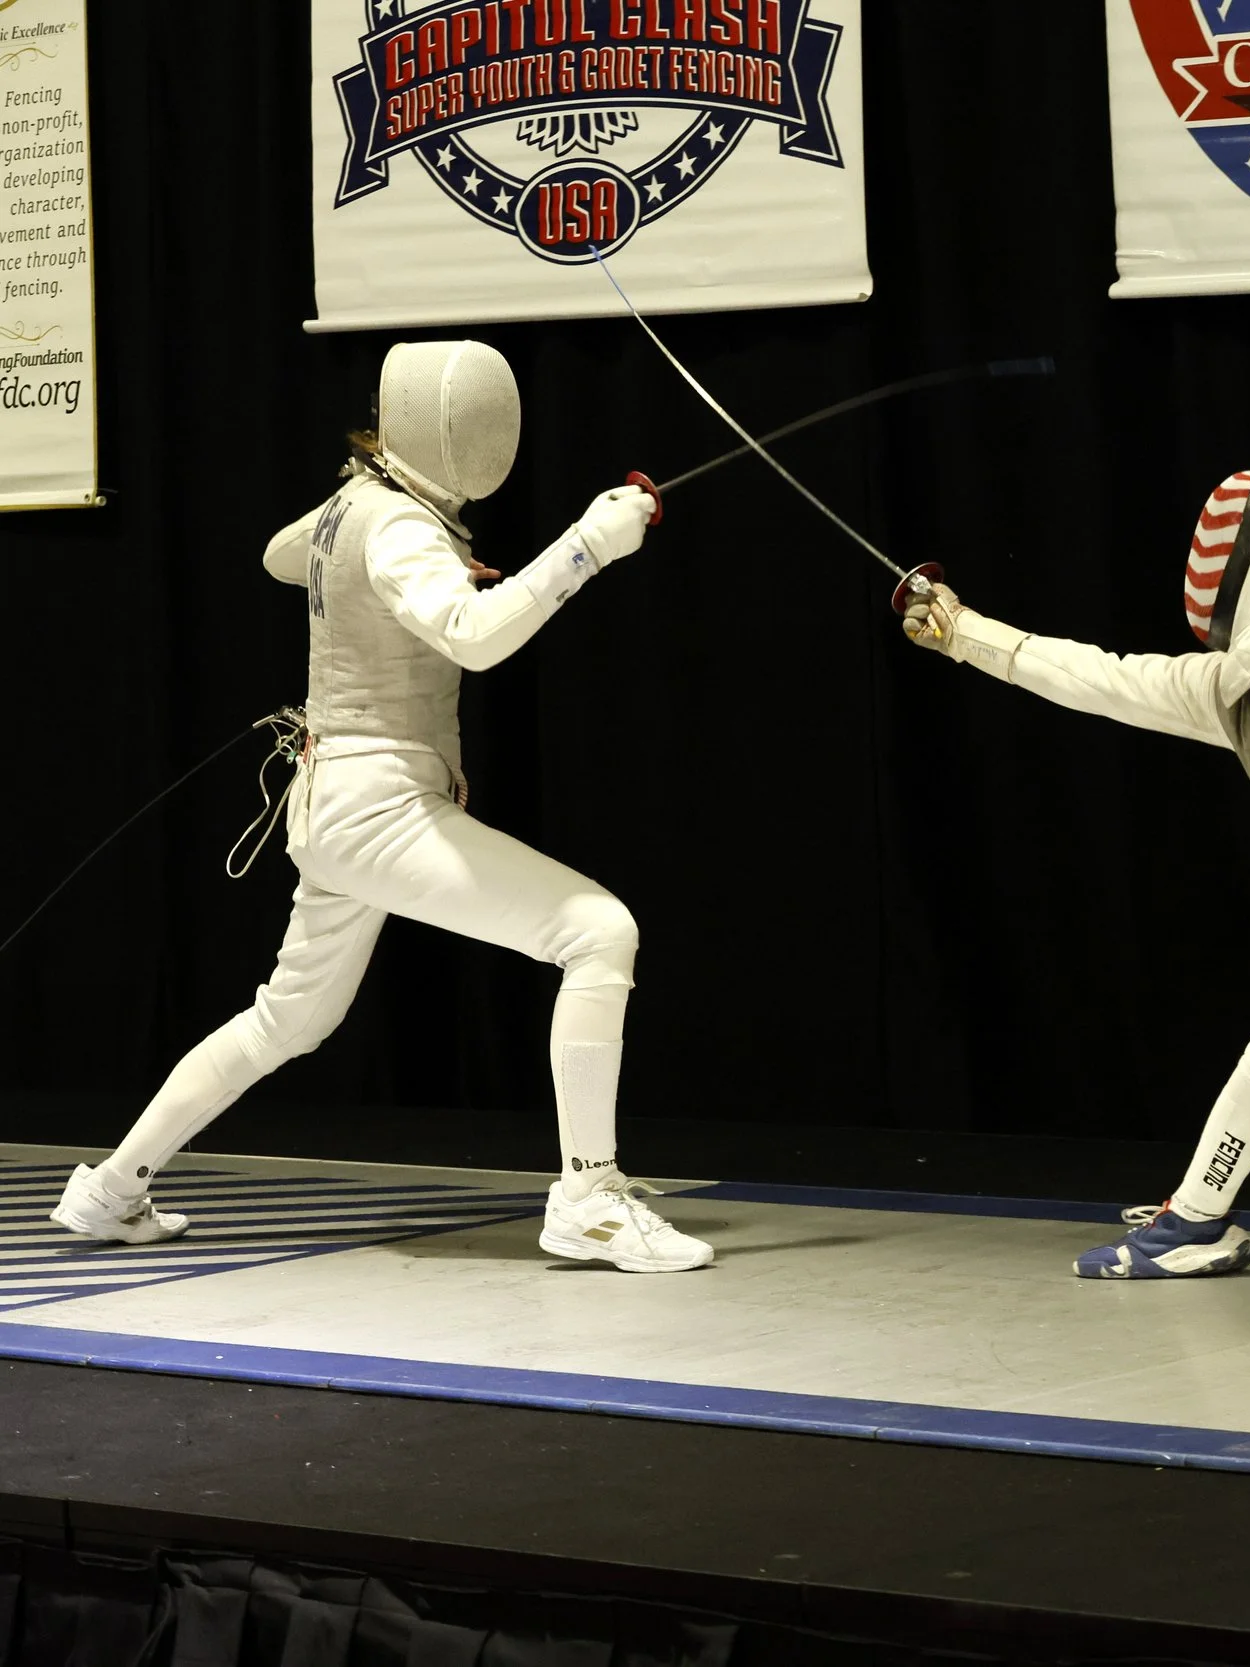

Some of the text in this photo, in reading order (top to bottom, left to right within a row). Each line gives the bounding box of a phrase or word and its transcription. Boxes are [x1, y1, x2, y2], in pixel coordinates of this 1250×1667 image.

[11, 22, 66, 40] Excellence
[384, 0, 781, 91] CAPITOL CLASH
[5, 86, 62, 107] Fencing
[385, 72, 464, 140] SUPER
[468, 52, 553, 109] YOUTH
[581, 46, 664, 92] CADET
[669, 47, 782, 106] FENCING
[2, 110, 83, 135] non-profit,
[3, 166, 84, 189] developing
[10, 194, 85, 215] character,
[537, 178, 618, 245] USA
[57, 218, 86, 238] and
[27, 246, 86, 269] through
[2, 278, 63, 303] fencing.
[1203, 1131, 1246, 1192] FENCING
